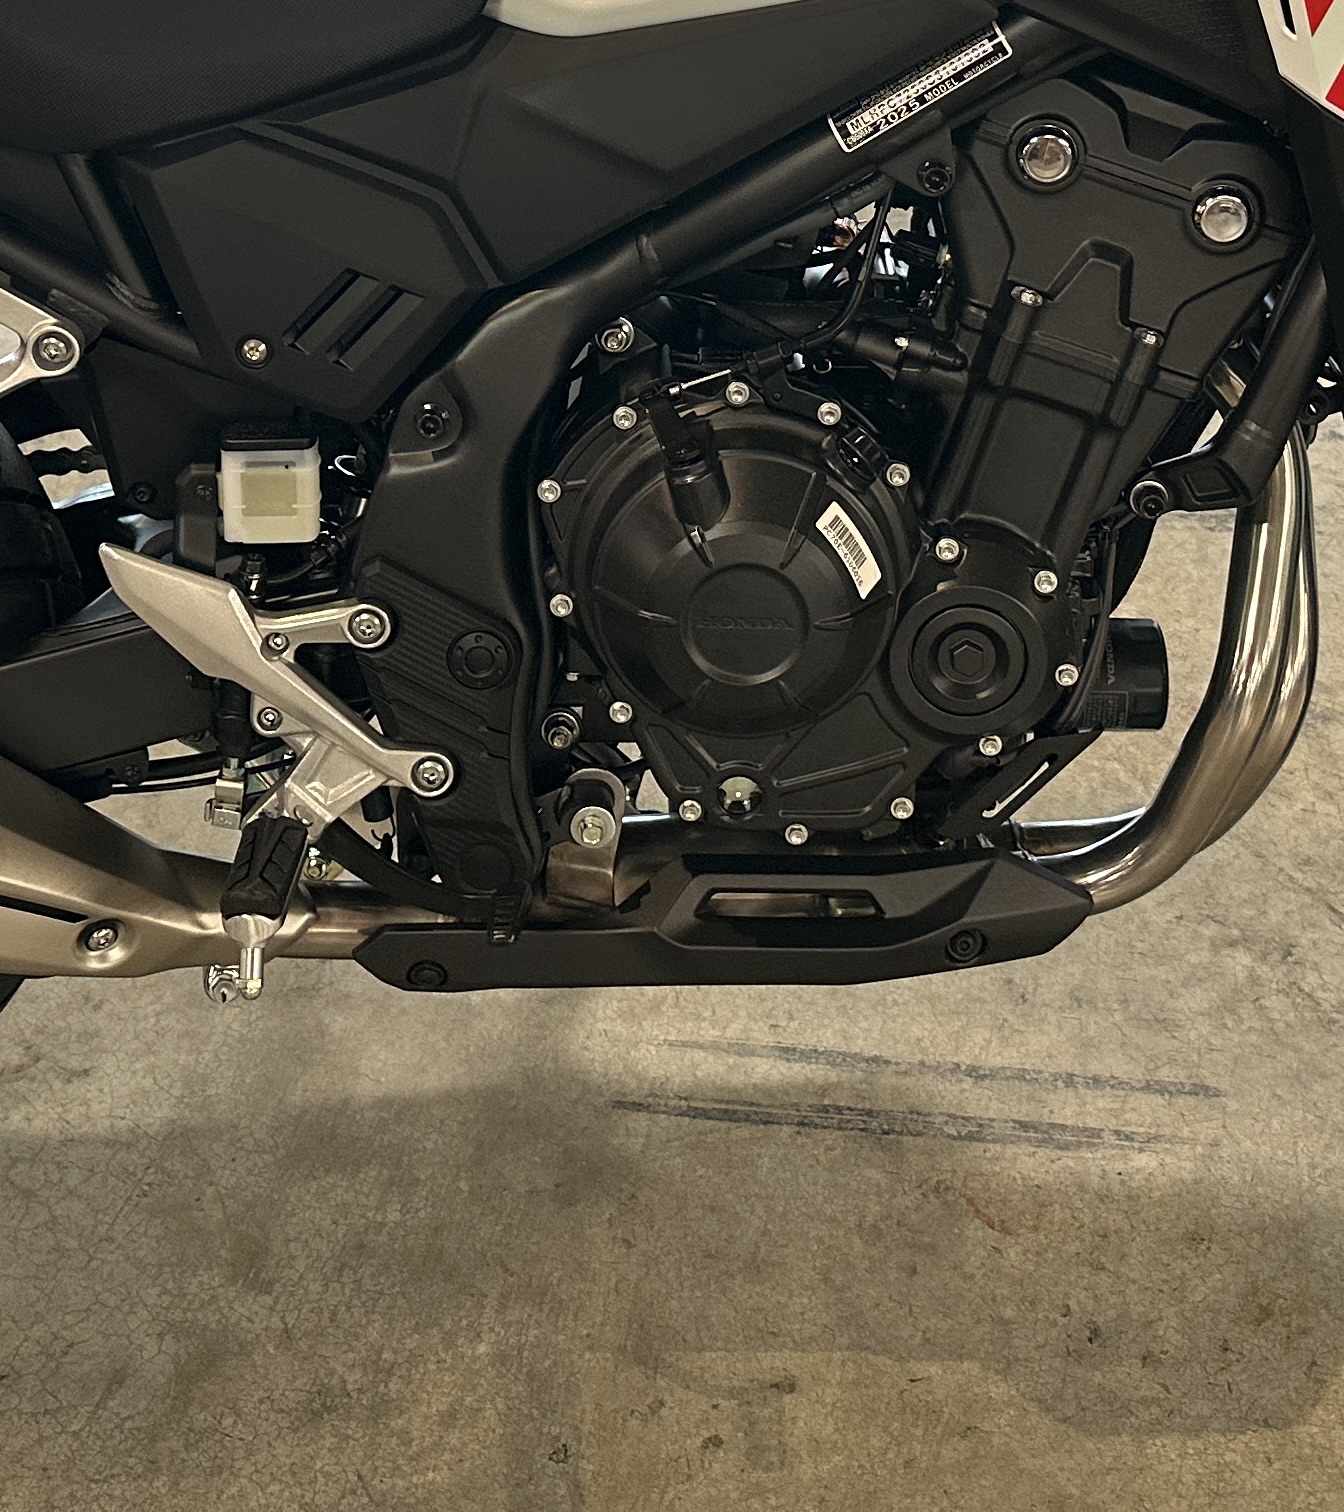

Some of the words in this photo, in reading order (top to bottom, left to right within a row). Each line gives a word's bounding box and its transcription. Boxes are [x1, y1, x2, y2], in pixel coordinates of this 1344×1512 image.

[878, 99, 921, 132] 2025
[923, 78, 959, 103] MODEL
[696, 615, 797, 631] HONDA
